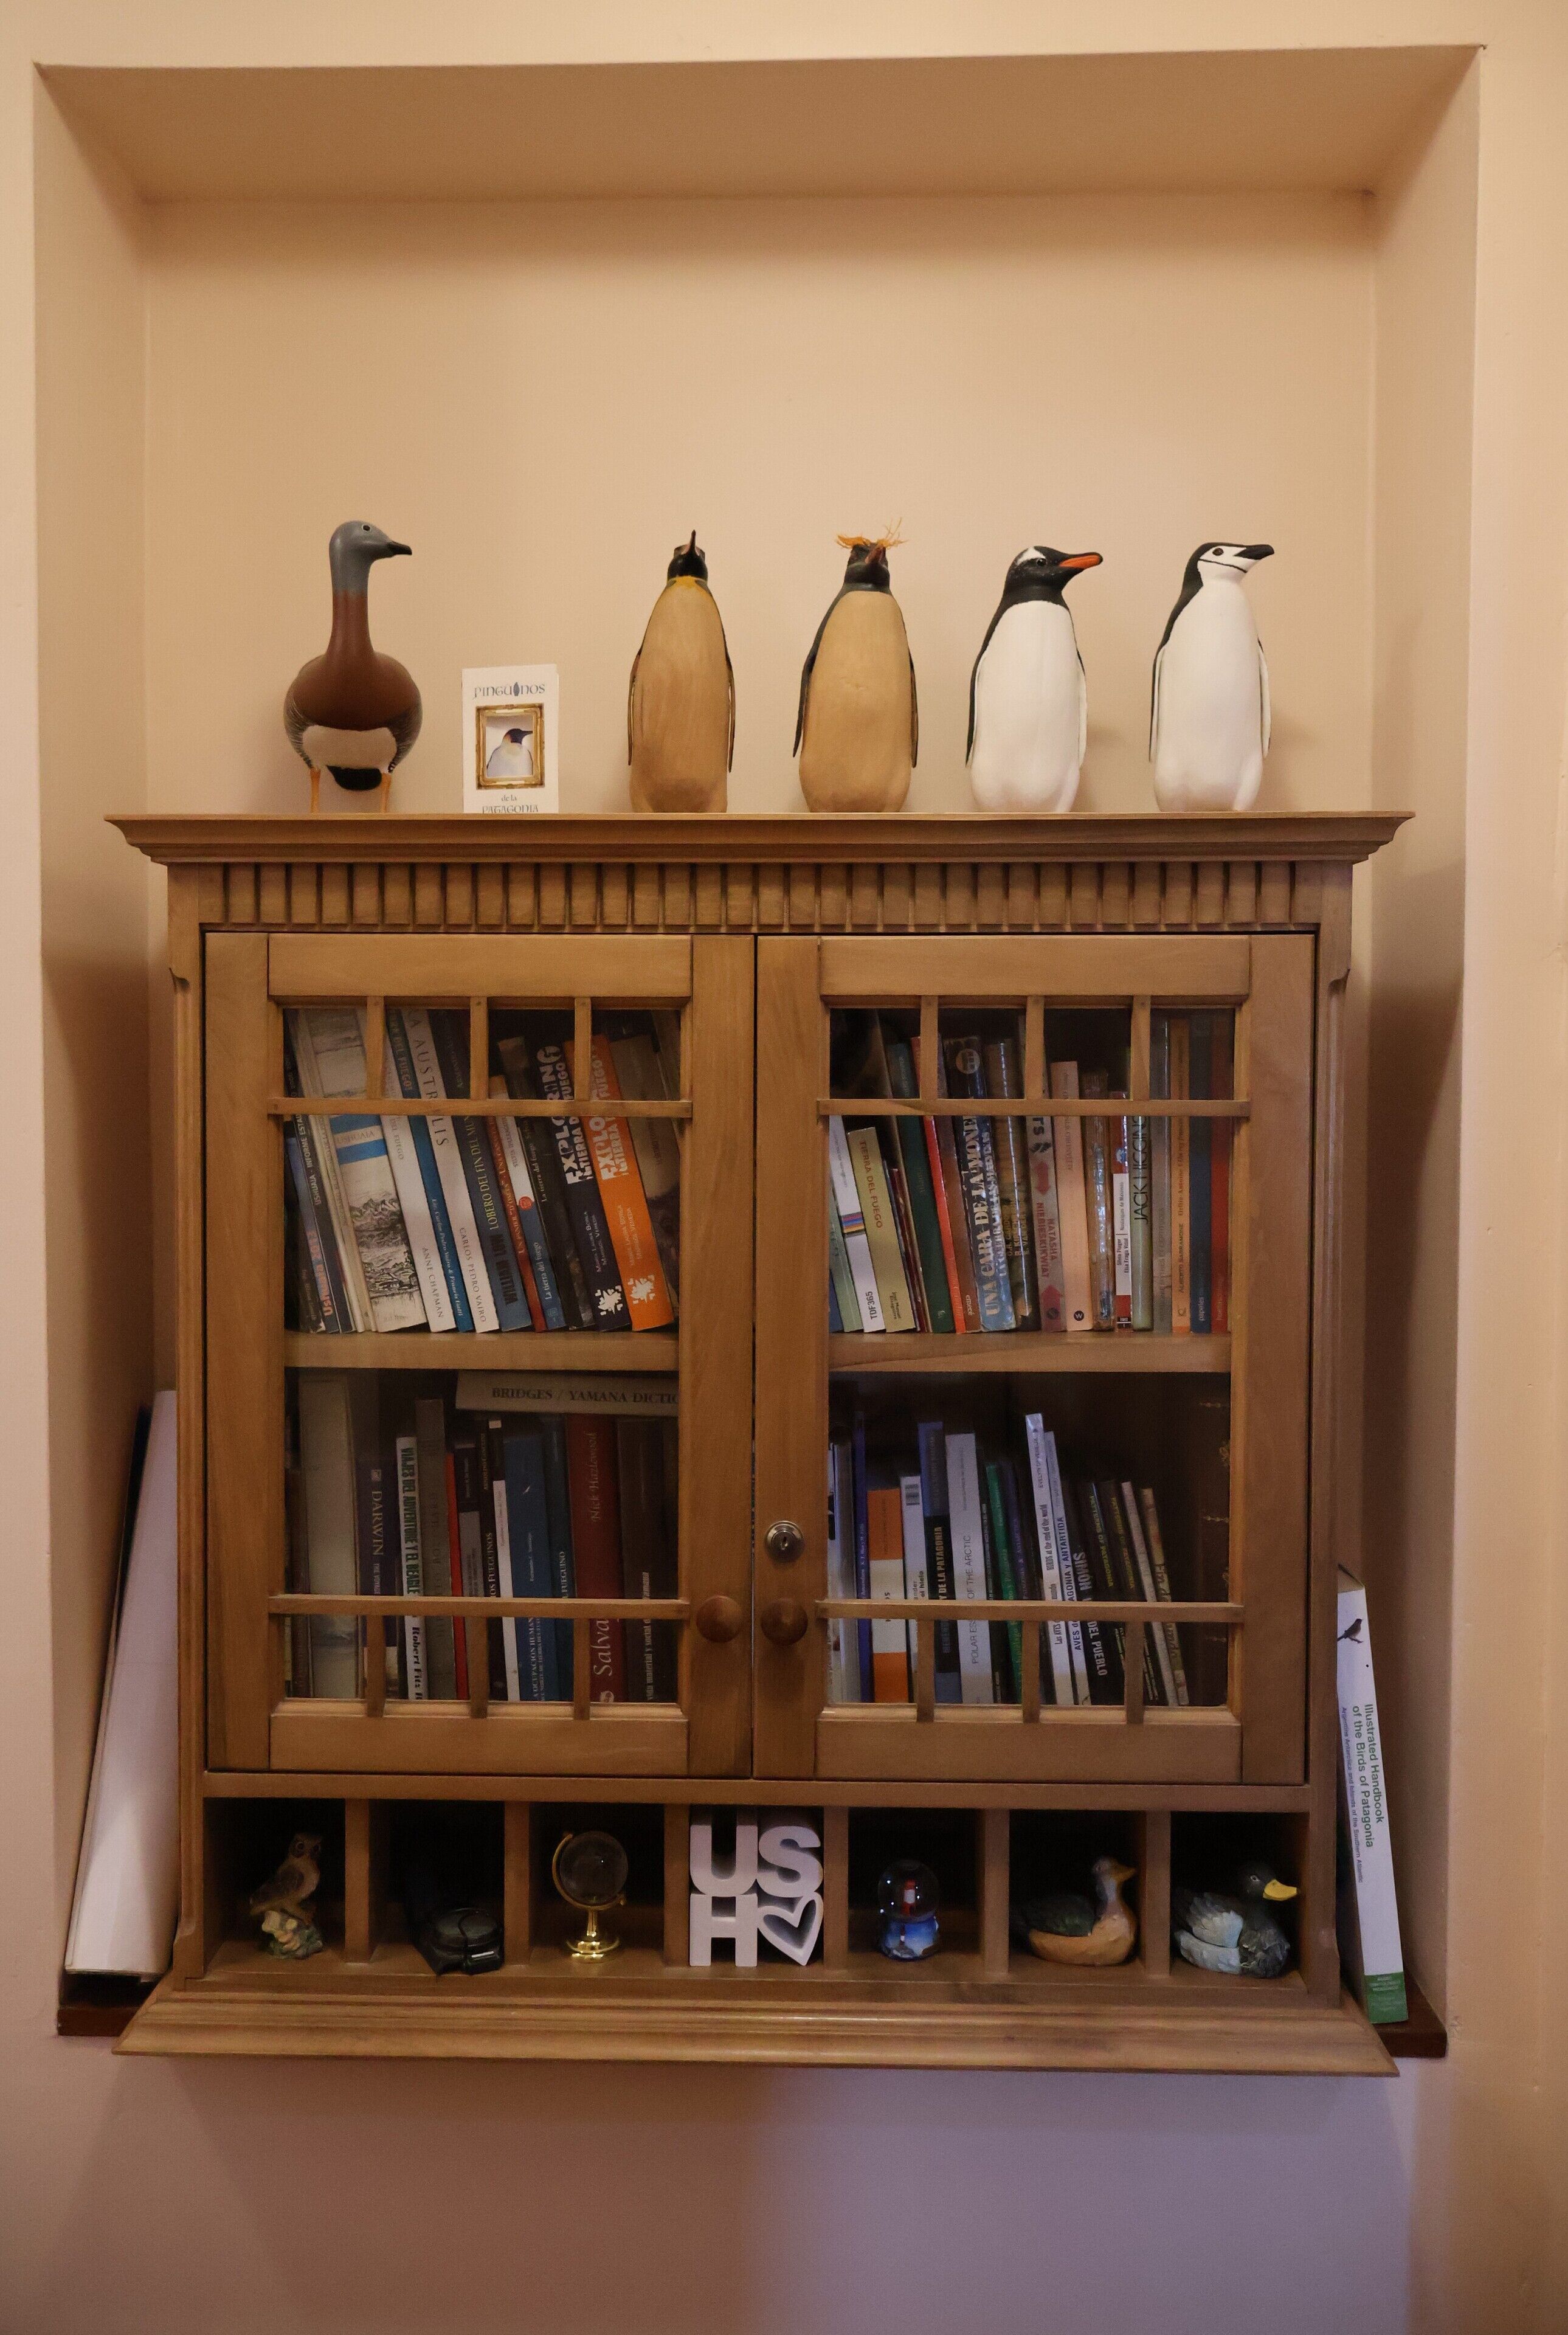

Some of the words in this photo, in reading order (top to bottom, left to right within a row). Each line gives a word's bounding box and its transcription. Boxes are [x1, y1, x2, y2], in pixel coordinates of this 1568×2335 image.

[482, 804, 539, 814] PATAGONIA
[409, 1038, 452, 1146] AUSTRLIS
[555, 1060, 573, 1101] FUEGO
[300, 1135, 313, 1168] INFORME
[394, 1134, 404, 1160] FUEGO
[468, 1138, 480, 1155] DEL
[859, 1140, 872, 1172] TIERRA
[961, 1115, 983, 1169] MONE
[473, 1156, 485, 1172] FIN
[309, 1174, 322, 1205] USHUAIA
[477, 1174, 489, 1191] DEL
[535, 1174, 545, 1192] tierra
[866, 1175, 876, 1193] DEL
[968, 1172, 986, 1199] LA
[482, 1192, 499, 1230] LOBERO
[539, 1193, 547, 1202] La
[869, 1195, 883, 1228] FUEGO
[1133, 1184, 1147, 1223] JACK
[972, 1201, 989, 1225] DE
[531, 1241, 544, 1260] fuego
[975, 1228, 996, 1278] CARA
[1044, 1218, 1060, 1261] NATASHA
[459, 1227, 472, 1260] CARLOS
[468, 1263, 480, 1292] PEDRO
[475, 1295, 486, 1322] VAIRO
[535, 1261, 545, 1271] del
[421, 1247, 433, 1270] ANNE
[427, 1274, 445, 1318] CHAPMAN
[539, 1272, 550, 1290] tierra
[543, 1291, 552, 1299] La
[865, 1290, 877, 1319] TDF365
[982, 1281, 1000, 1316] UNA
[491, 1386, 553, 1400] BRIDGES
[568, 1389, 627, 1402] YAMANA
[400, 1447, 414, 1476] VIAJES
[402, 1479, 415, 1493] DEL
[370, 1491, 384, 1556] DARWIN
[402, 1495, 418, 1543] ADVENTURE
[1039, 1504, 1048, 1518] world
[933, 1526, 945, 1571] PATAGONIA
[962, 1535, 973, 1566] ARCTIC
[1055, 1516, 1069, 1562] ANTARTIDA
[405, 1553, 418, 1562] EL
[485, 1532, 495, 1582] FUEGUINOS
[558, 1551, 568, 1592] FUEGUINO
[1045, 1555, 1054, 1570] BIRDS
[1099, 1545, 1114, 1587] PATAGONIA
[406, 1563, 420, 1594] BEAGLE
[937, 1572, 946, 1582] LA
[938, 1583, 947, 1593] DE
[964, 1568, 974, 1585] THE
[1063, 1571, 1075, 1602] AGONIA
[966, 1587, 975, 1599] OF
[1052, 1623, 1062, 1635] AVES
[1054, 1636, 1063, 1644] Las
[1072, 1630, 1082, 1650] AVES
[1086, 1620, 1100, 1639] DEL
[411, 1626, 423, 1664] Robert
[589, 1618, 612, 1676] Salva
[969, 1635, 980, 1664] POLAR
[1091, 1640, 1108, 1676] PUEBLO
[1352, 1705, 1361, 1717] of
[1353, 1720, 1364, 1738] the
[1364, 1703, 1378, 1760] Illustrated
[1355, 1742, 1367, 1771] Birds
[1359, 1774, 1369, 1787] of
[1370, 1764, 1384, 1823] Handbook
[1358, 1790, 1375, 1848] Patagonia
[1353, 1828, 1361, 1858] Southern
[689, 1825, 823, 1898] US
